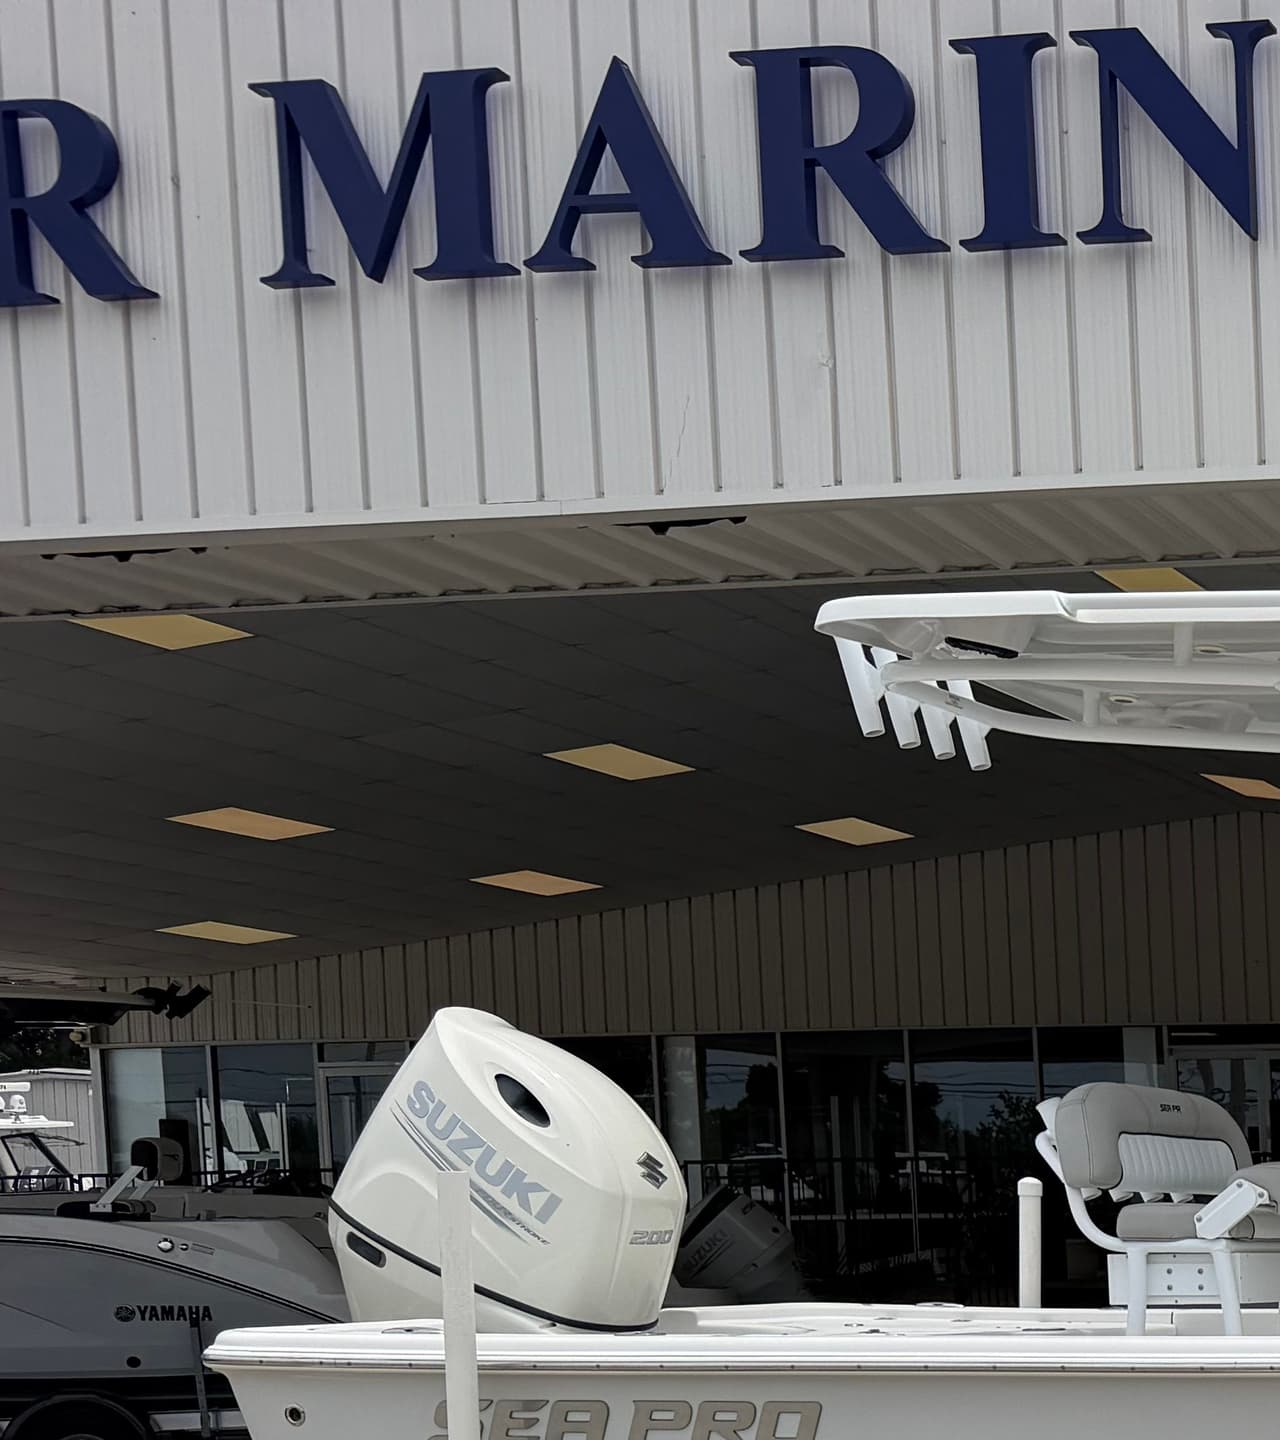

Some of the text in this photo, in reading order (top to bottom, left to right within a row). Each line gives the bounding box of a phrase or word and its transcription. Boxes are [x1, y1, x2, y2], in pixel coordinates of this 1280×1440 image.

[0, 98, 160, 307] R
[405, 1080, 563, 1225] SUZUKI
[628, 1229, 674, 1246] 200
[136, 1304, 213, 1322] YAMAHA
